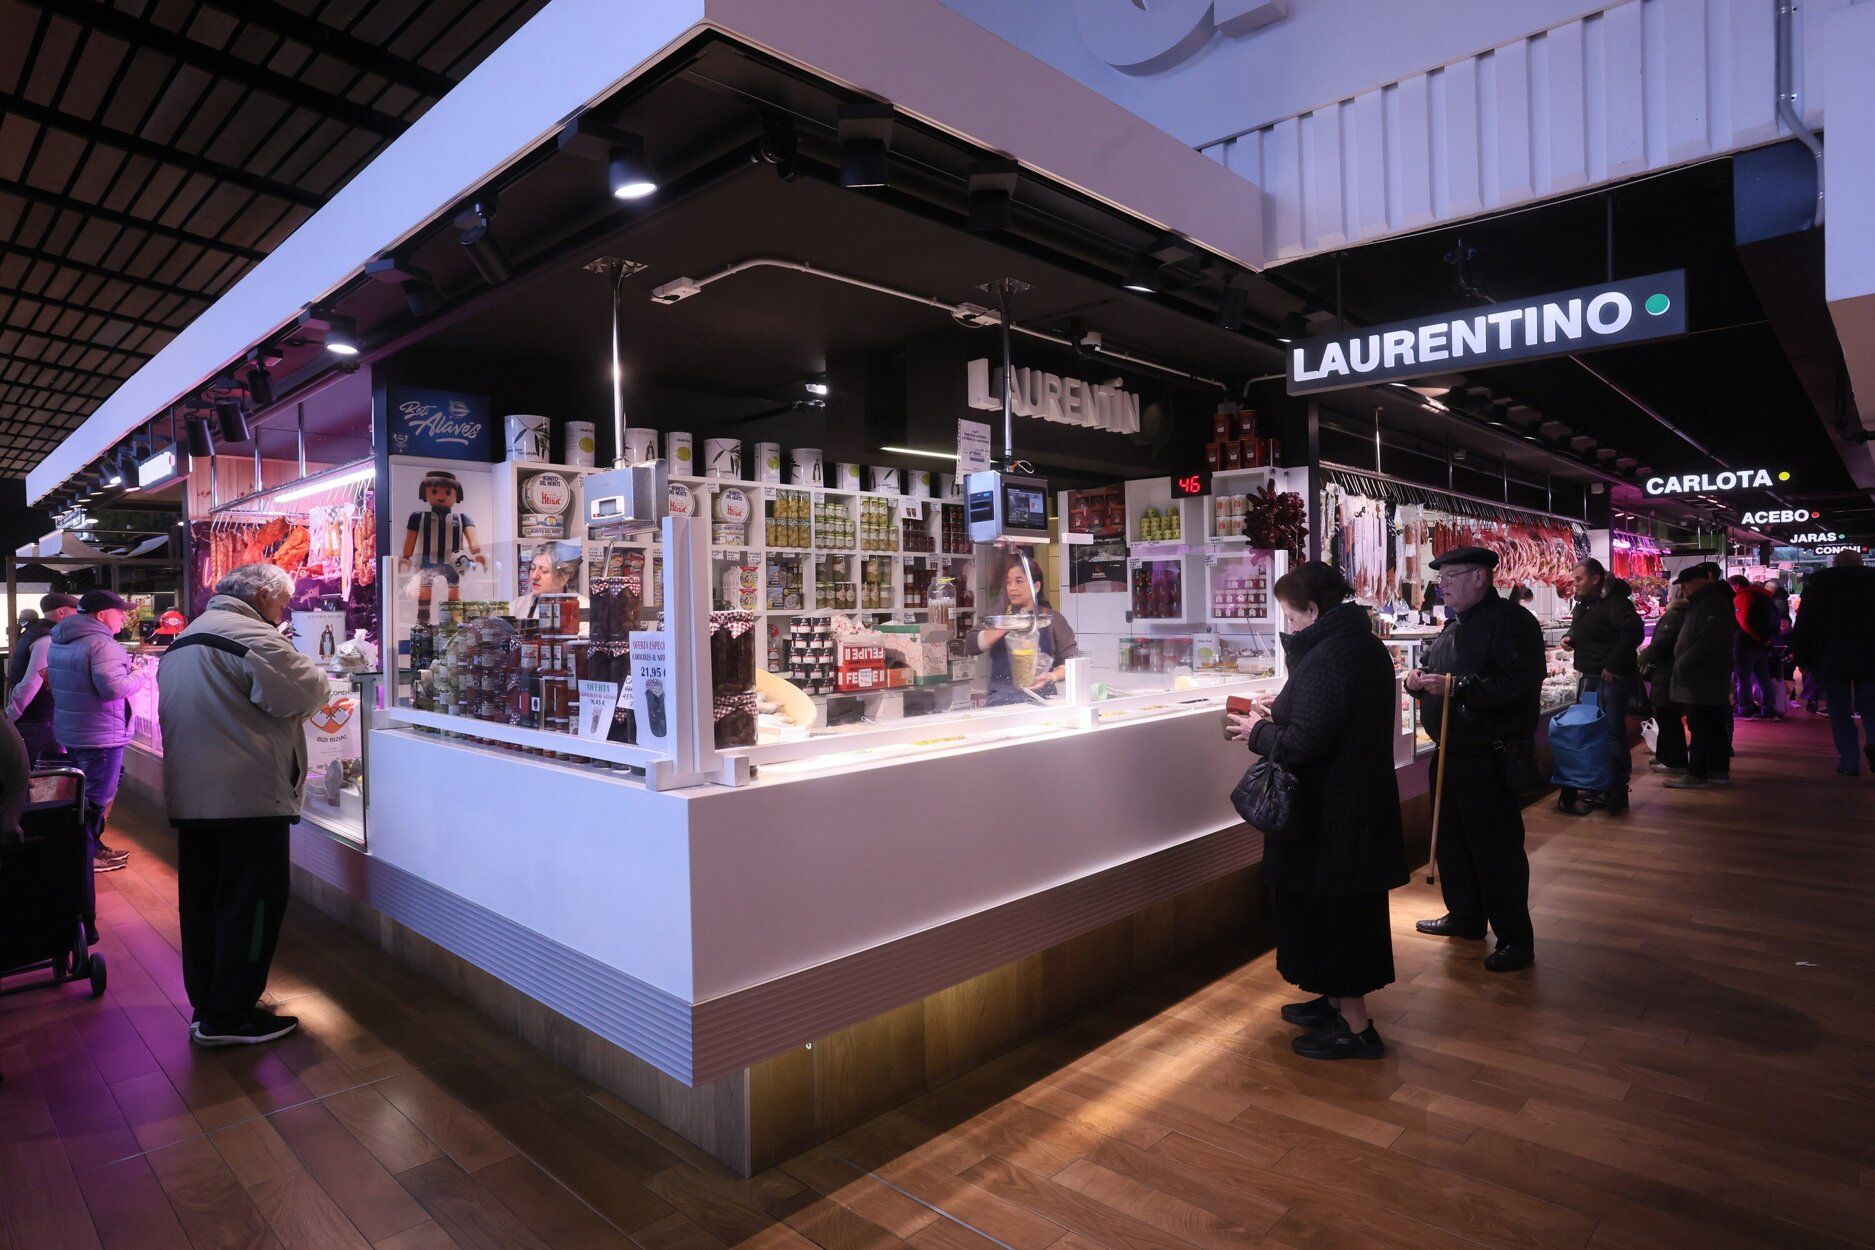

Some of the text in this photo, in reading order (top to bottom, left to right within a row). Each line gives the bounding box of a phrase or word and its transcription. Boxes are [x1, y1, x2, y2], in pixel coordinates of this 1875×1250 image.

[1293, 291, 1634, 382] LAURENTINO
[1179, 476, 1200, 493] 46
[1646, 469, 1773, 495] CARLOTA
[1742, 509, 1809, 525] ACEBO
[1790, 532, 1837, 544] JARAS
[633, 640, 648, 650] OFERTA
[852, 647, 884, 660] FELIPE
[641, 667, 662, 678] 21,95
[846, 671, 878, 684] FEE
[586, 683, 610, 692] OFERTA
